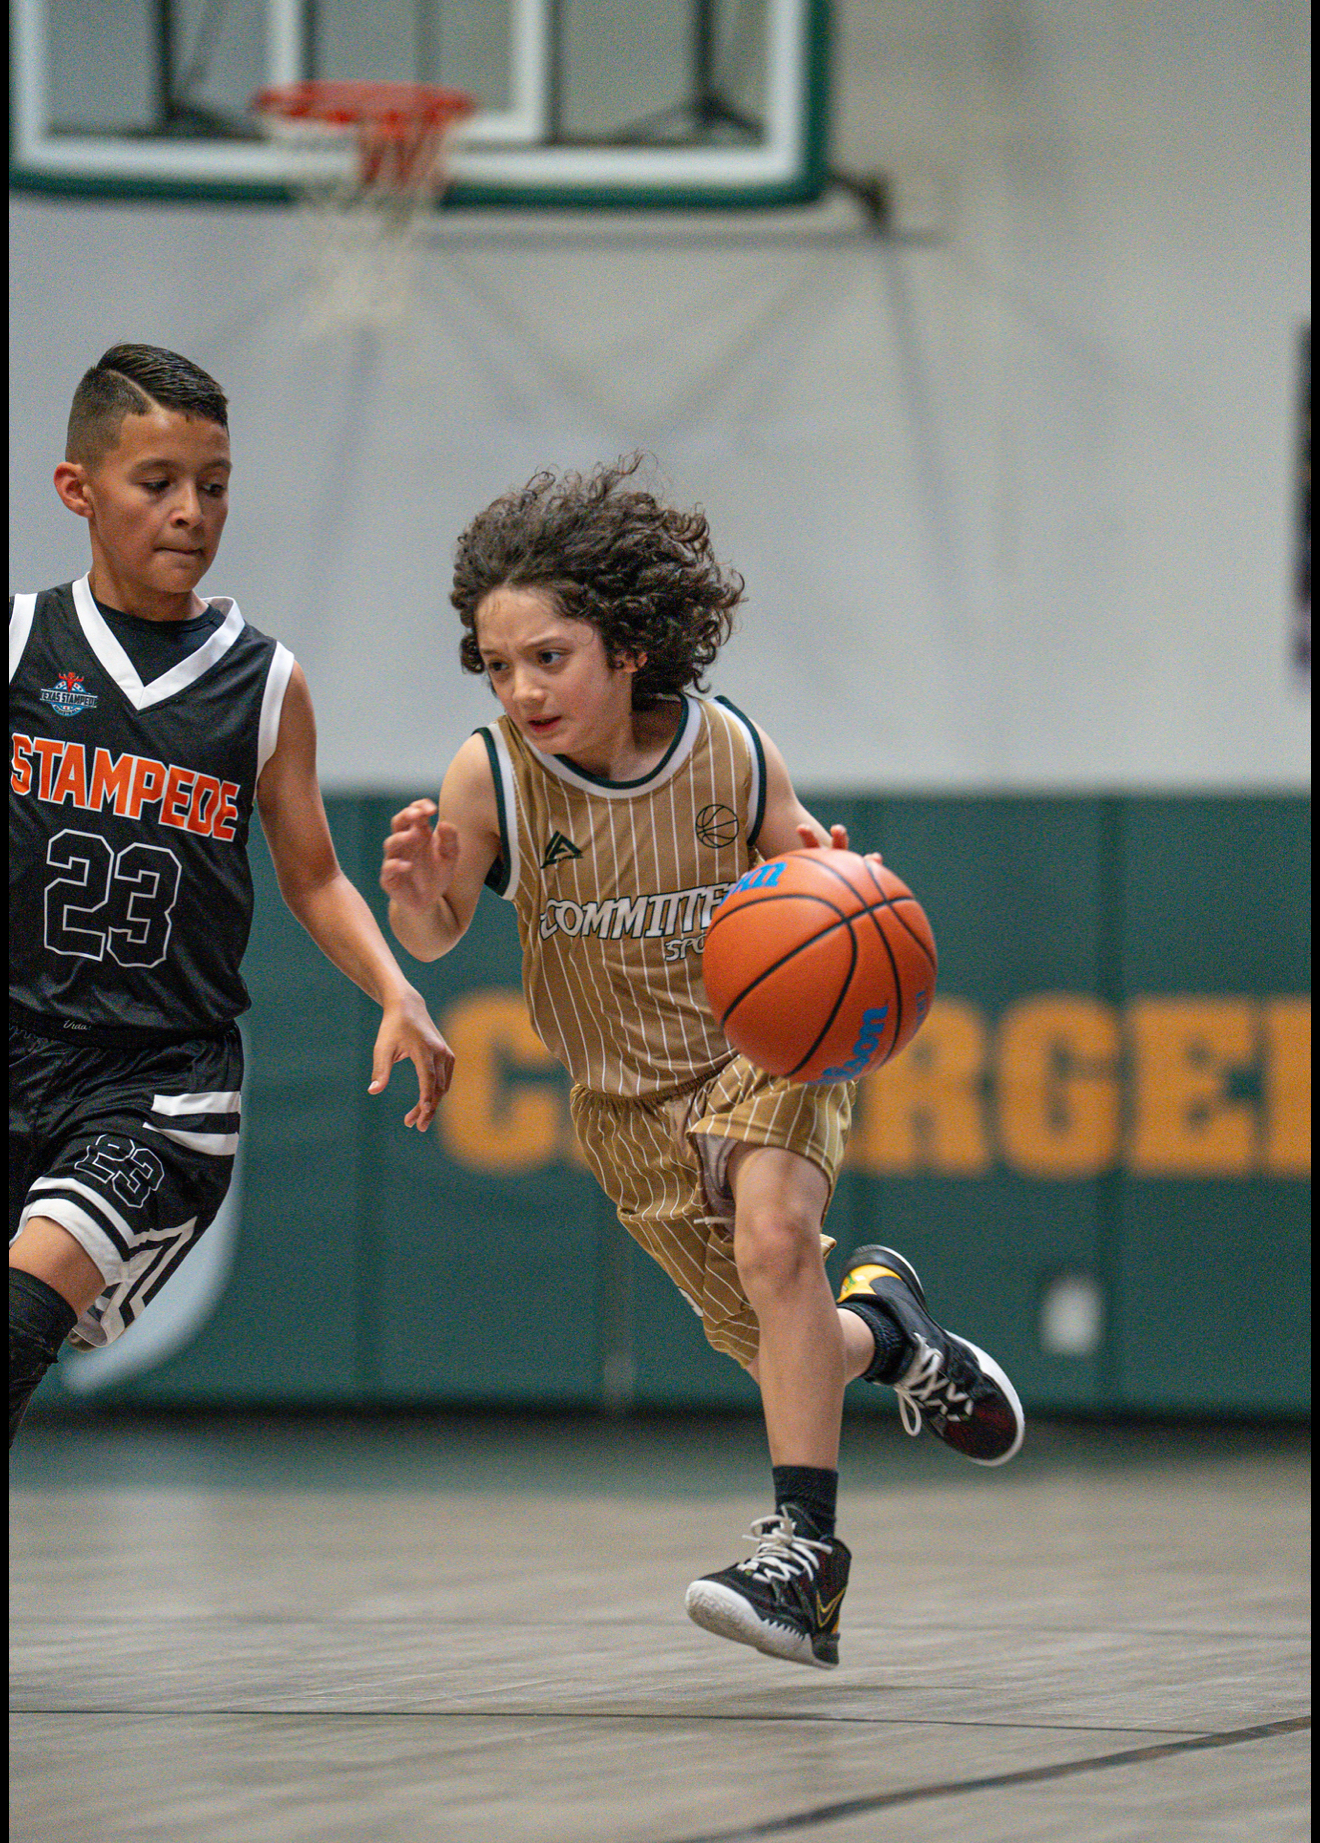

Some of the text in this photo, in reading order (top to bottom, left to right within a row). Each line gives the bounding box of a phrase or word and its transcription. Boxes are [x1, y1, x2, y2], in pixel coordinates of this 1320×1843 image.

[11, 733, 241, 842] STAMPEDE
[44, 829, 182, 968] 23
[540, 881, 738, 941] COMMITTE
[438, 988, 1311, 1178] CRGE
[74, 1133, 165, 1208] 23
